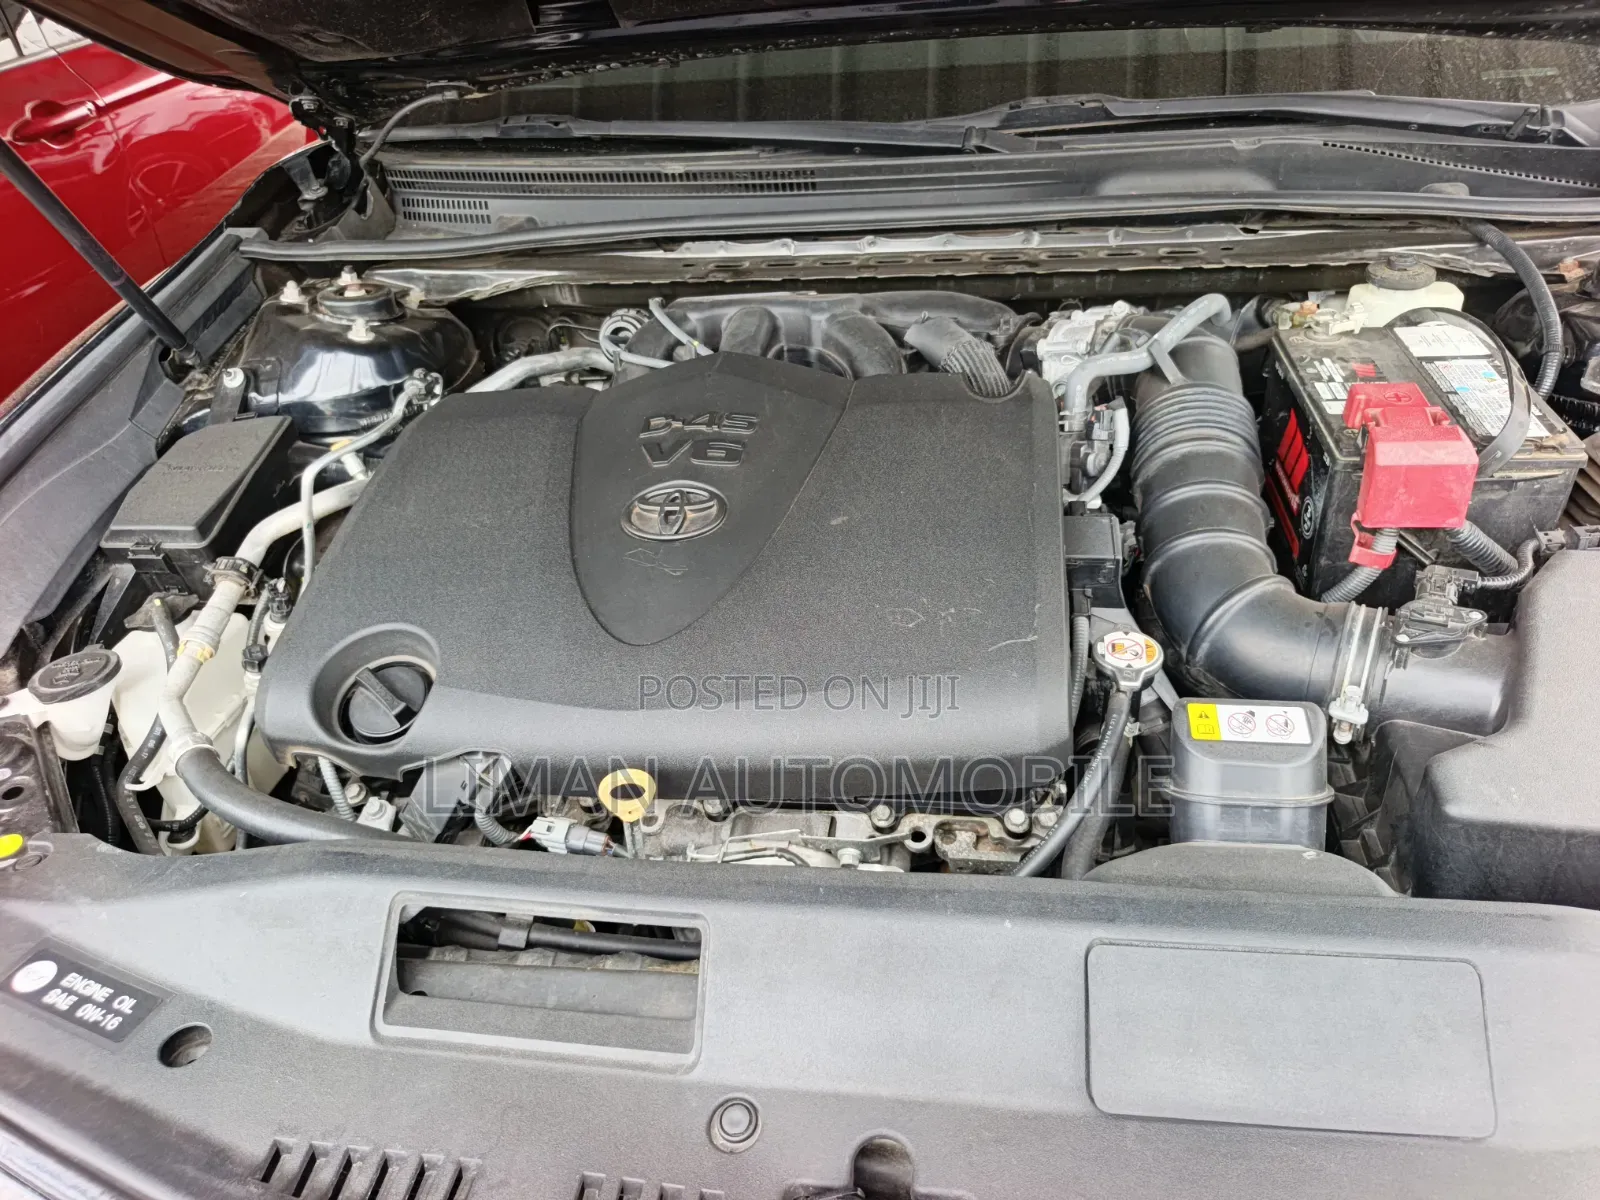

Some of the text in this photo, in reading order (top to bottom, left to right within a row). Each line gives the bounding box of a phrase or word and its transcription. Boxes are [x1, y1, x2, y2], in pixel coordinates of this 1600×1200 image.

[639, 412, 760, 438] D-4S
[641, 438, 748, 467] V6
[42, 988, 123, 1030] SAE 0W-16
[60, 972, 138, 1013] ENGINE OIL
